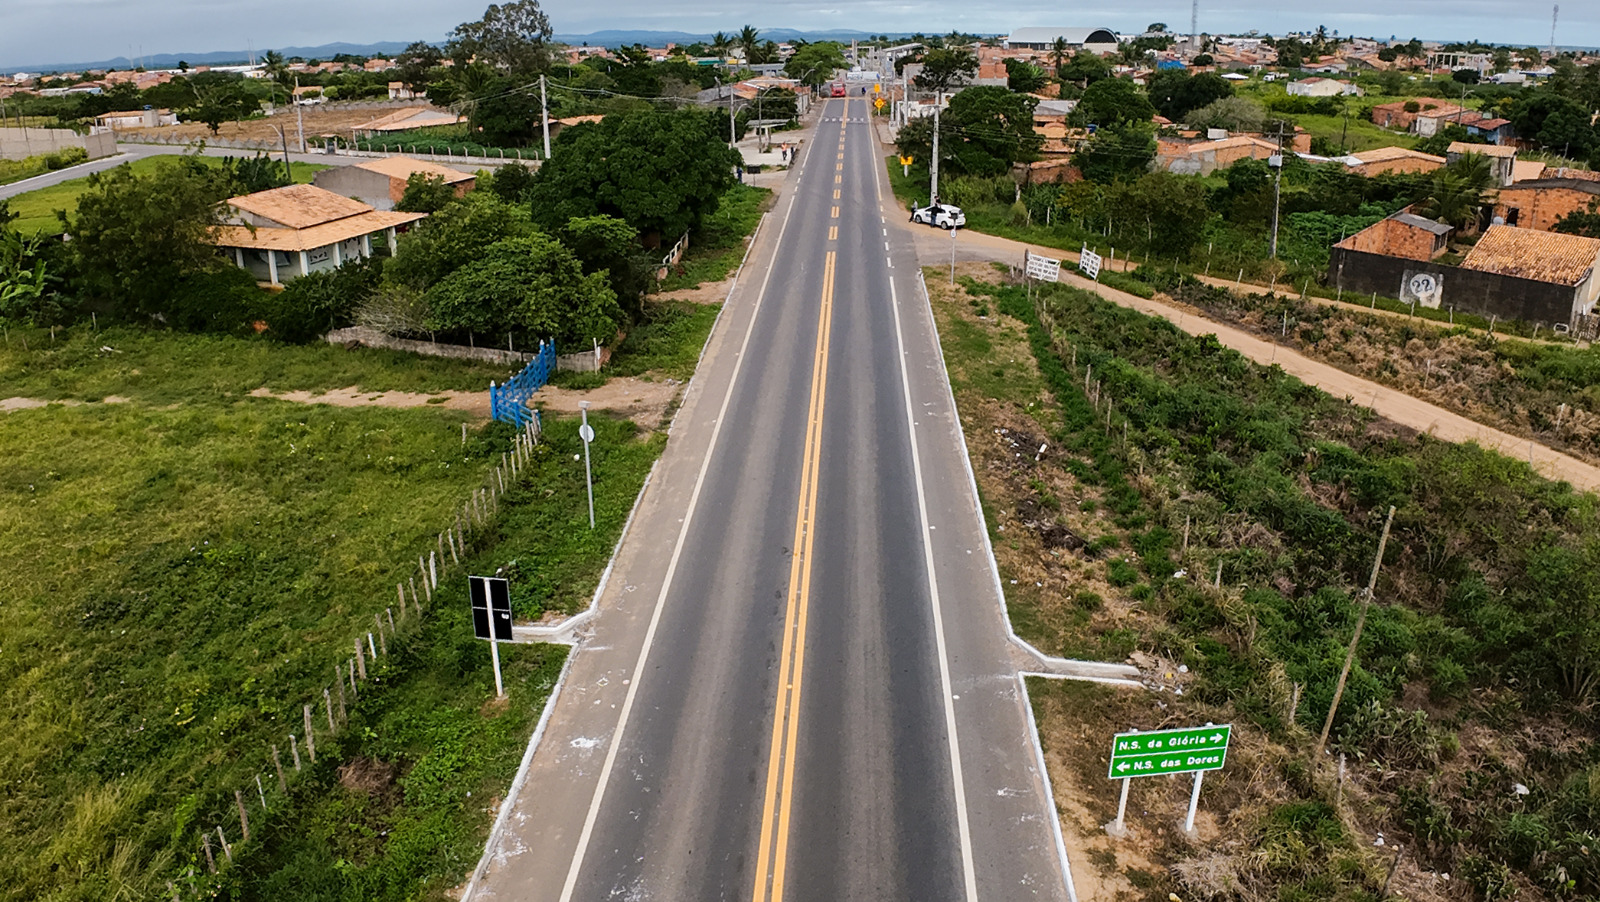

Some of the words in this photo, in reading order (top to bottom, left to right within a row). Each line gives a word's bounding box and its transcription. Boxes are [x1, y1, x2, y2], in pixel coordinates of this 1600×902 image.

[1411, 278, 1433, 293] 22
[1119, 741, 1141, 751] N.S.
[1147, 739, 1162, 748] da
[1168, 735, 1206, 746] Glória
[1133, 761, 1154, 770] N.S.
[1160, 758, 1181, 768] das
[1187, 755, 1219, 765] Dores
